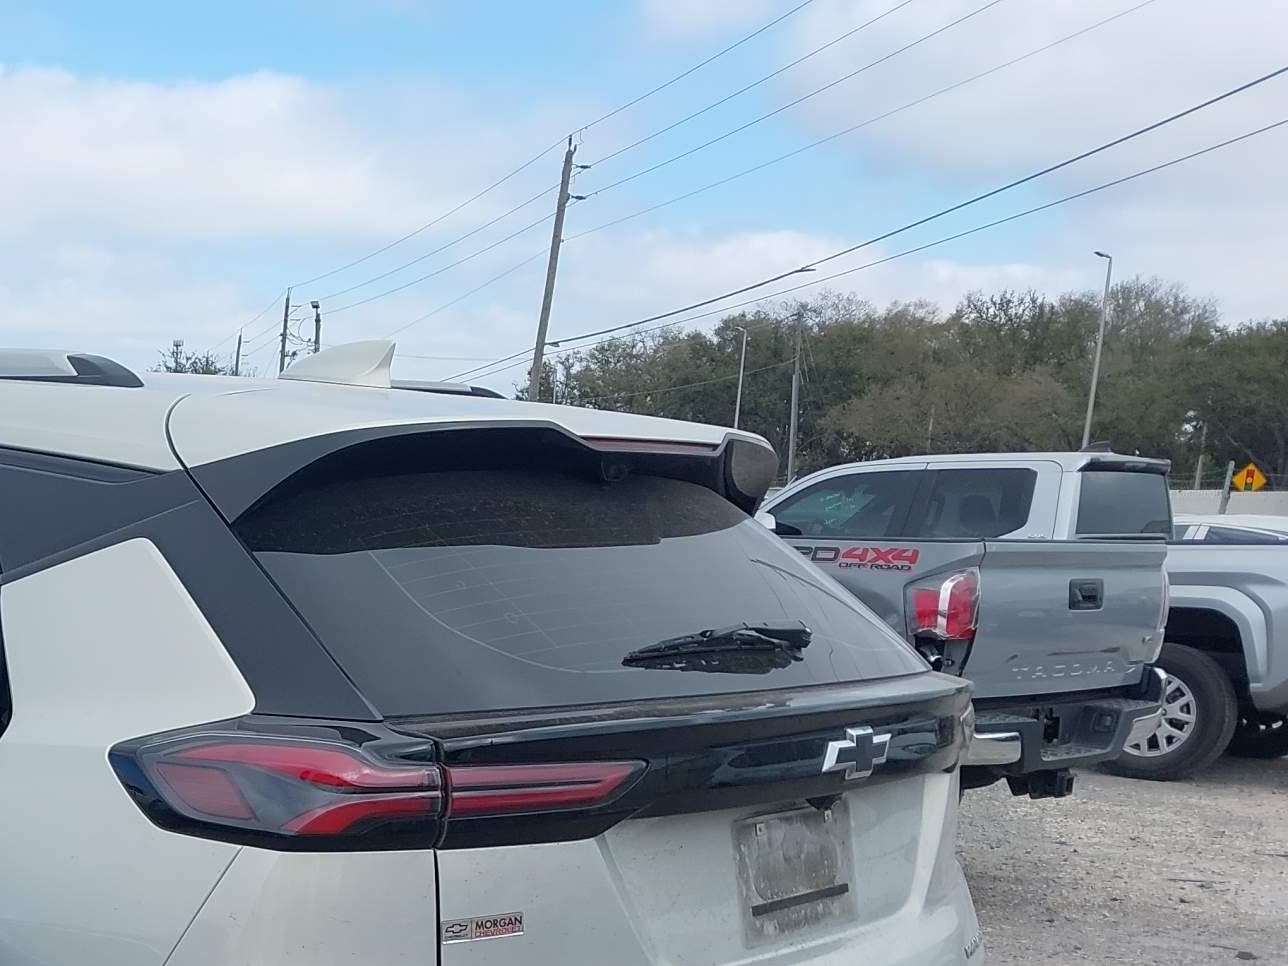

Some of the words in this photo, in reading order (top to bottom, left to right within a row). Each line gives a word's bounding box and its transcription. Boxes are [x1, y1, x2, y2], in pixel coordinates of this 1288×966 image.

[870, 563, 912, 572] ROAD
[1011, 660, 1116, 680] TACOMA
[474, 915, 523, 931] MORGAN
